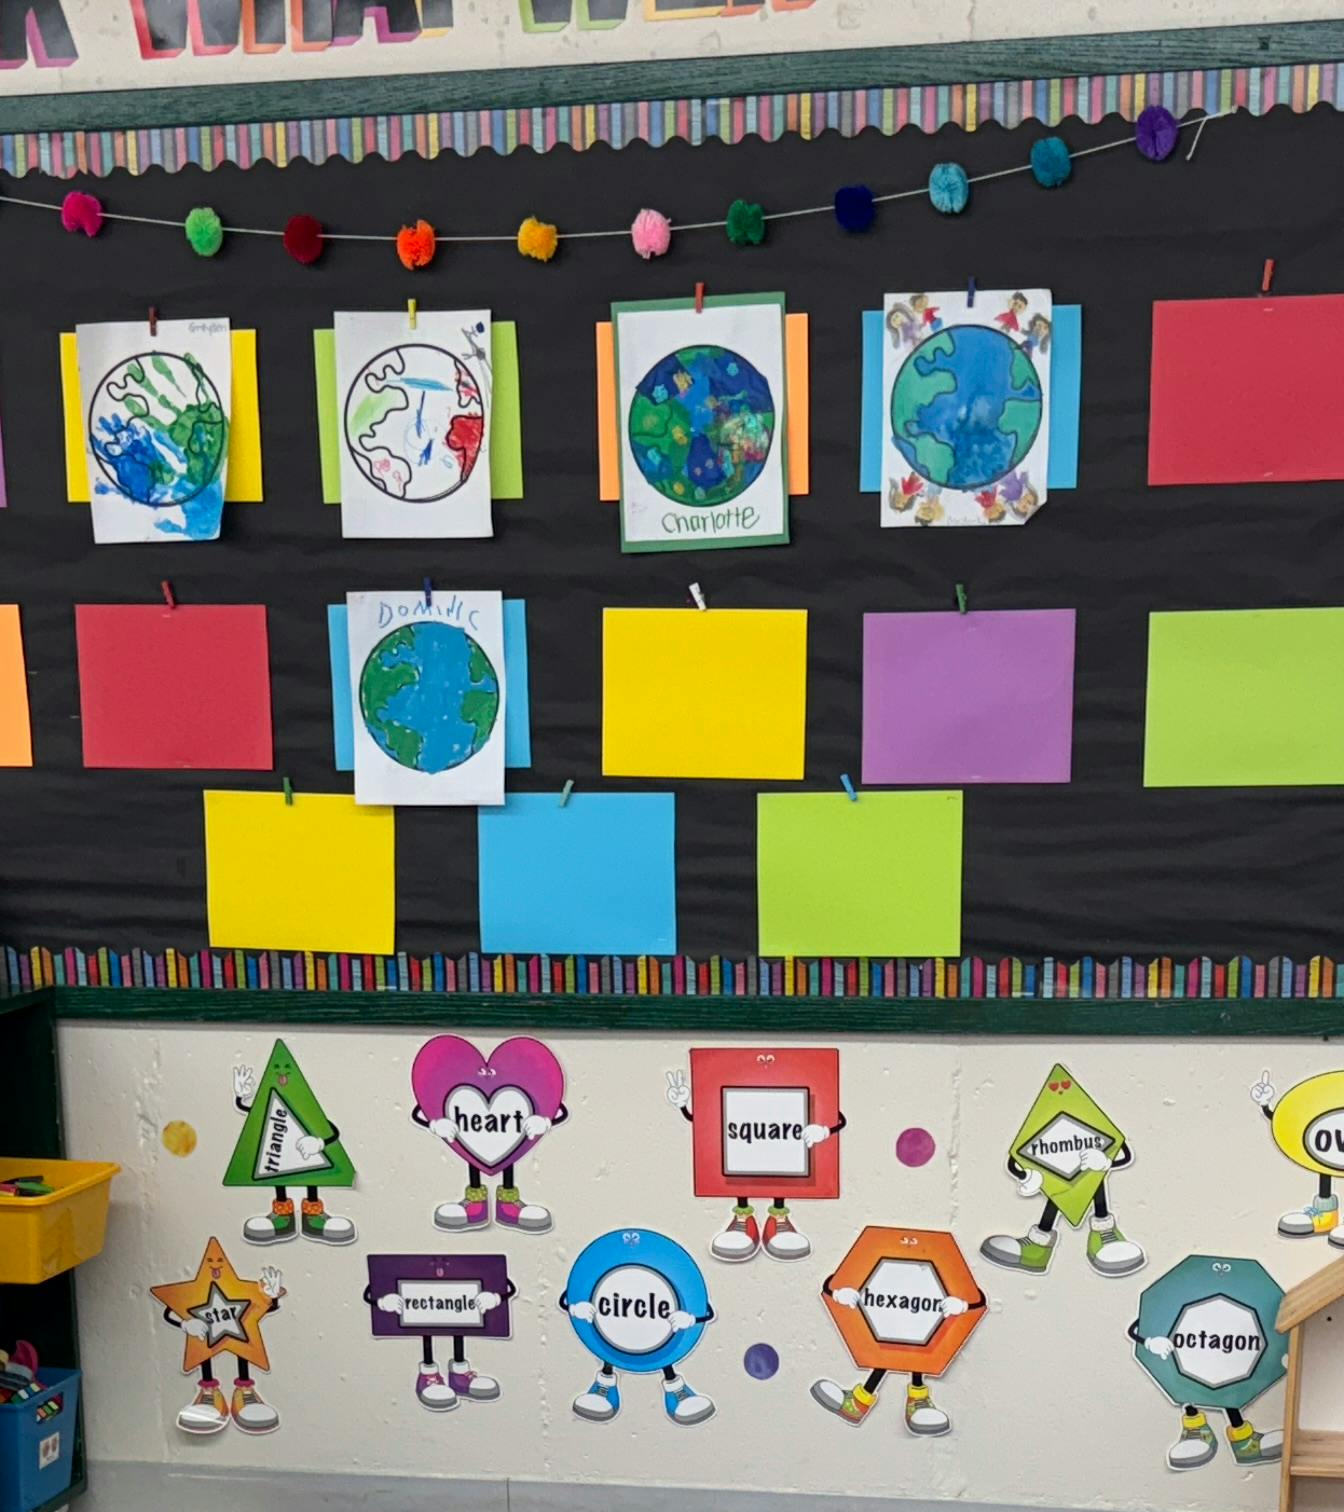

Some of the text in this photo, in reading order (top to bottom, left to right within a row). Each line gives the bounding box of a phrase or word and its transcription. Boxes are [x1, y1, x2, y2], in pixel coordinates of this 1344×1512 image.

[661, 505, 761, 535] Charlotte
[454, 1106, 524, 1135] heart
[727, 1121, 804, 1144] square
[265, 1107, 288, 1174] triangle
[1030, 1134, 1102, 1156] rhombus
[205, 1305, 238, 1325] star
[404, 1294, 477, 1313] rectangle
[598, 1292, 672, 1320] circle
[1172, 1330, 1261, 1354] octagon
